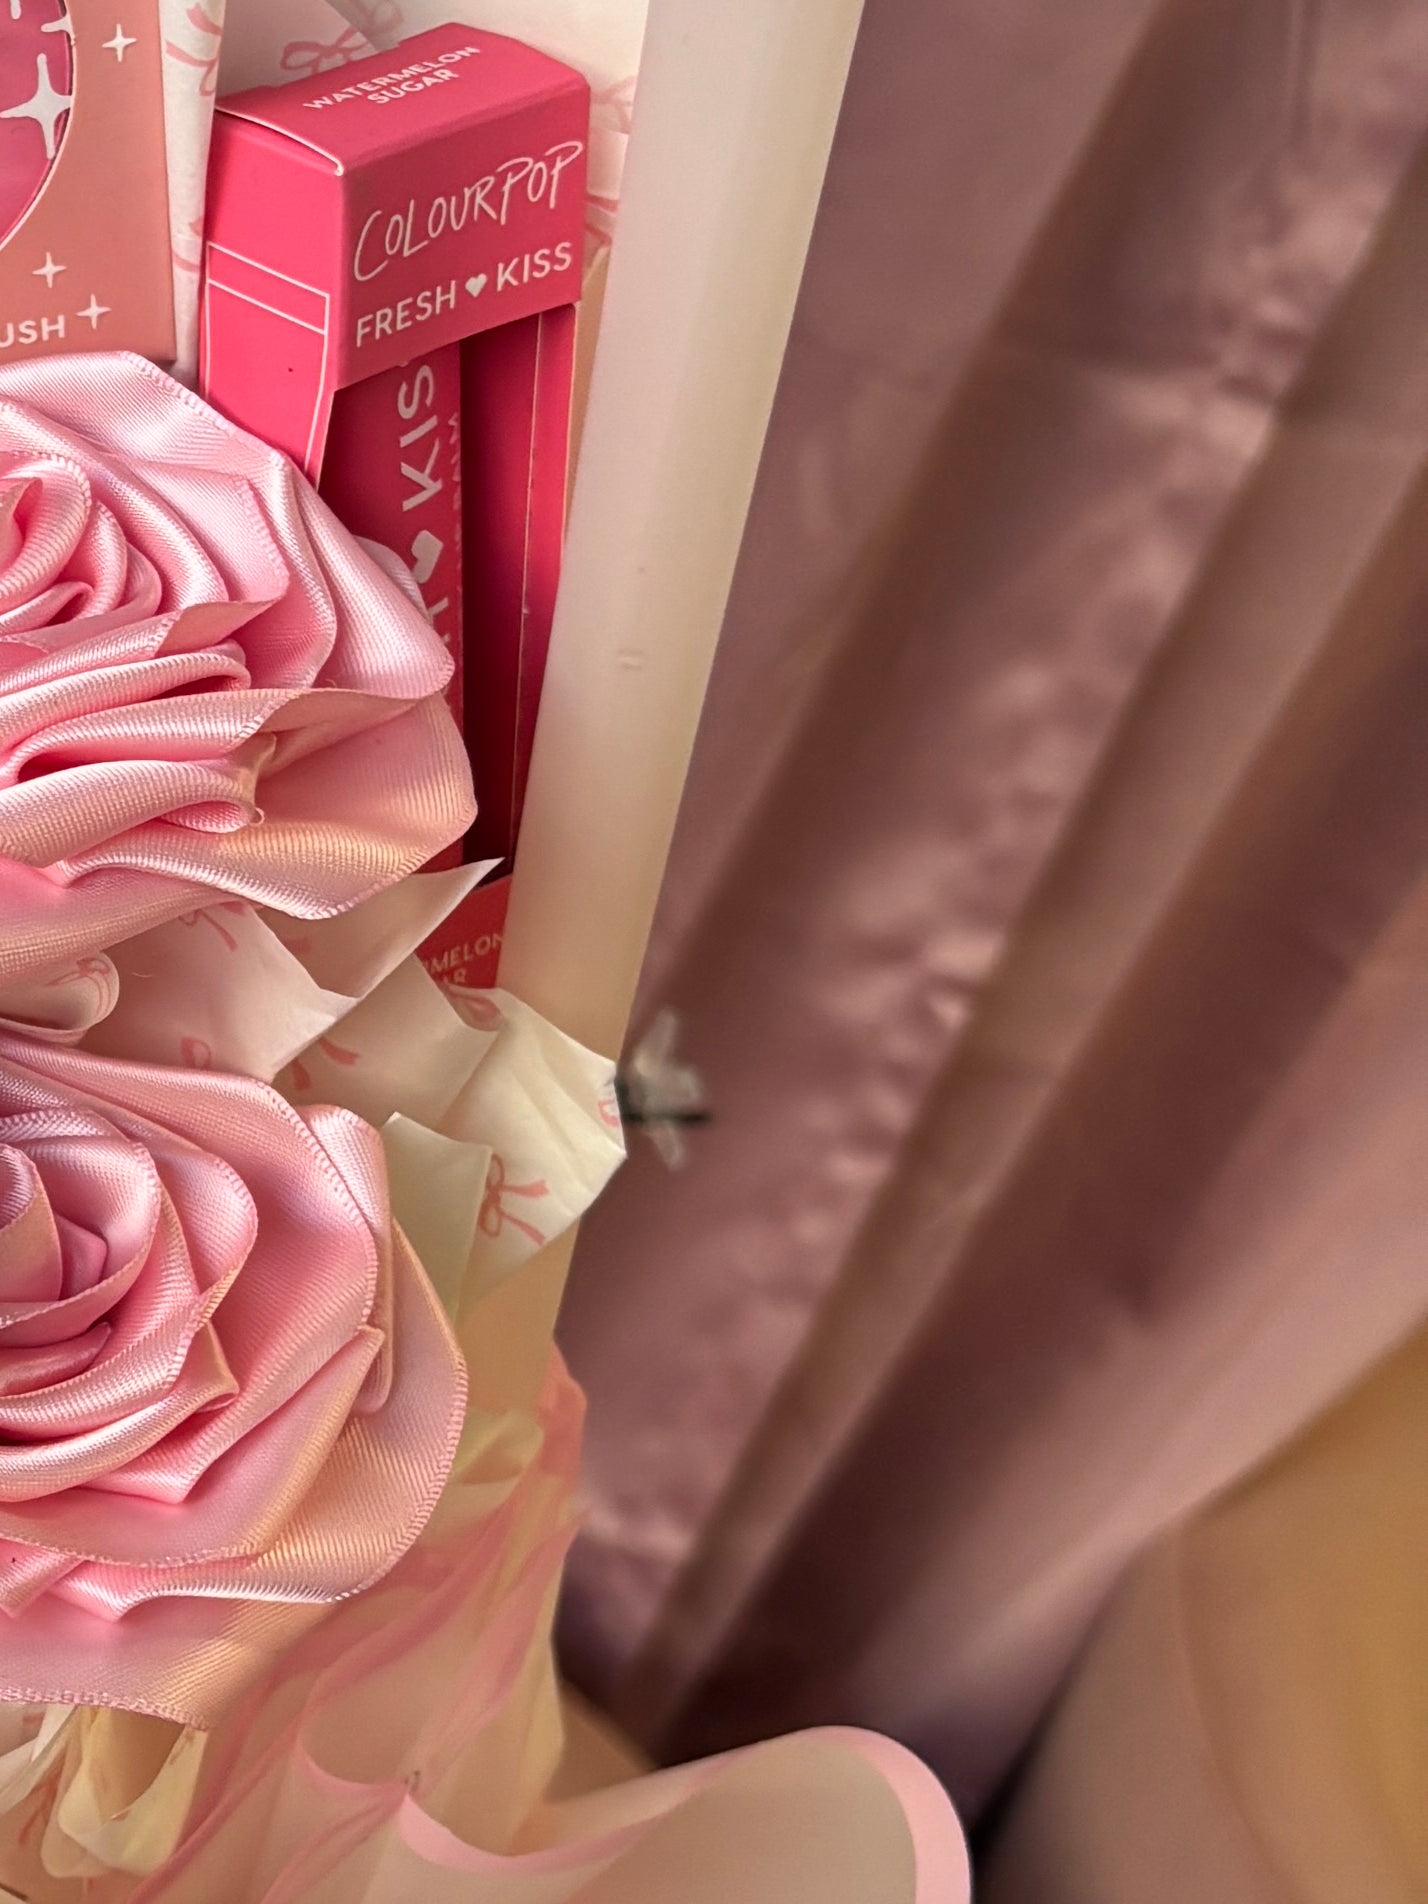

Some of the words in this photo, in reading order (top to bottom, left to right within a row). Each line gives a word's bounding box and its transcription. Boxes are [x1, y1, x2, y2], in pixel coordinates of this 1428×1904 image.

[302, 46, 481, 109] WATERMELON
[367, 68, 459, 105] SUGAR
[354, 140, 584, 282] COLOURPOP
[356, 280, 457, 348] FRESH
[496, 242, 572, 292] KISS
[397, 363, 443, 512] KIS
